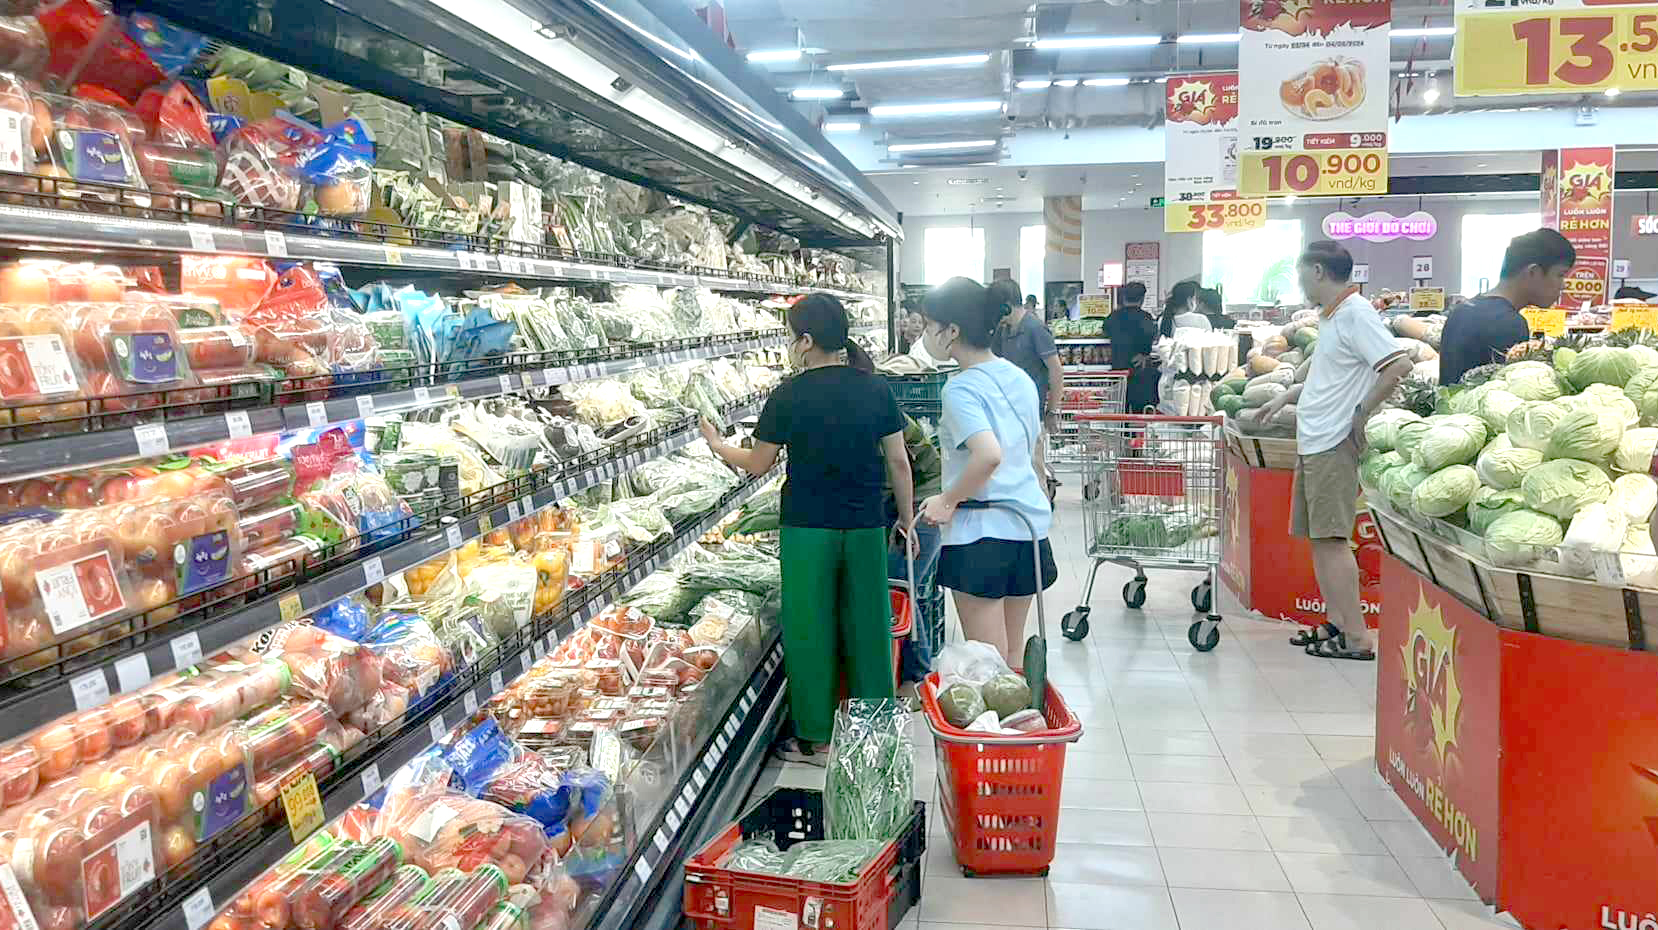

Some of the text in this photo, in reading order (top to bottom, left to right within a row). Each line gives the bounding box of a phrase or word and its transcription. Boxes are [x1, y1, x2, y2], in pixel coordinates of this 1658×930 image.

[1178, 90, 1207, 105] GIÁ
[1261, 153, 1381, 192] 10.900
[1568, 172, 1606, 189] GIÁ
